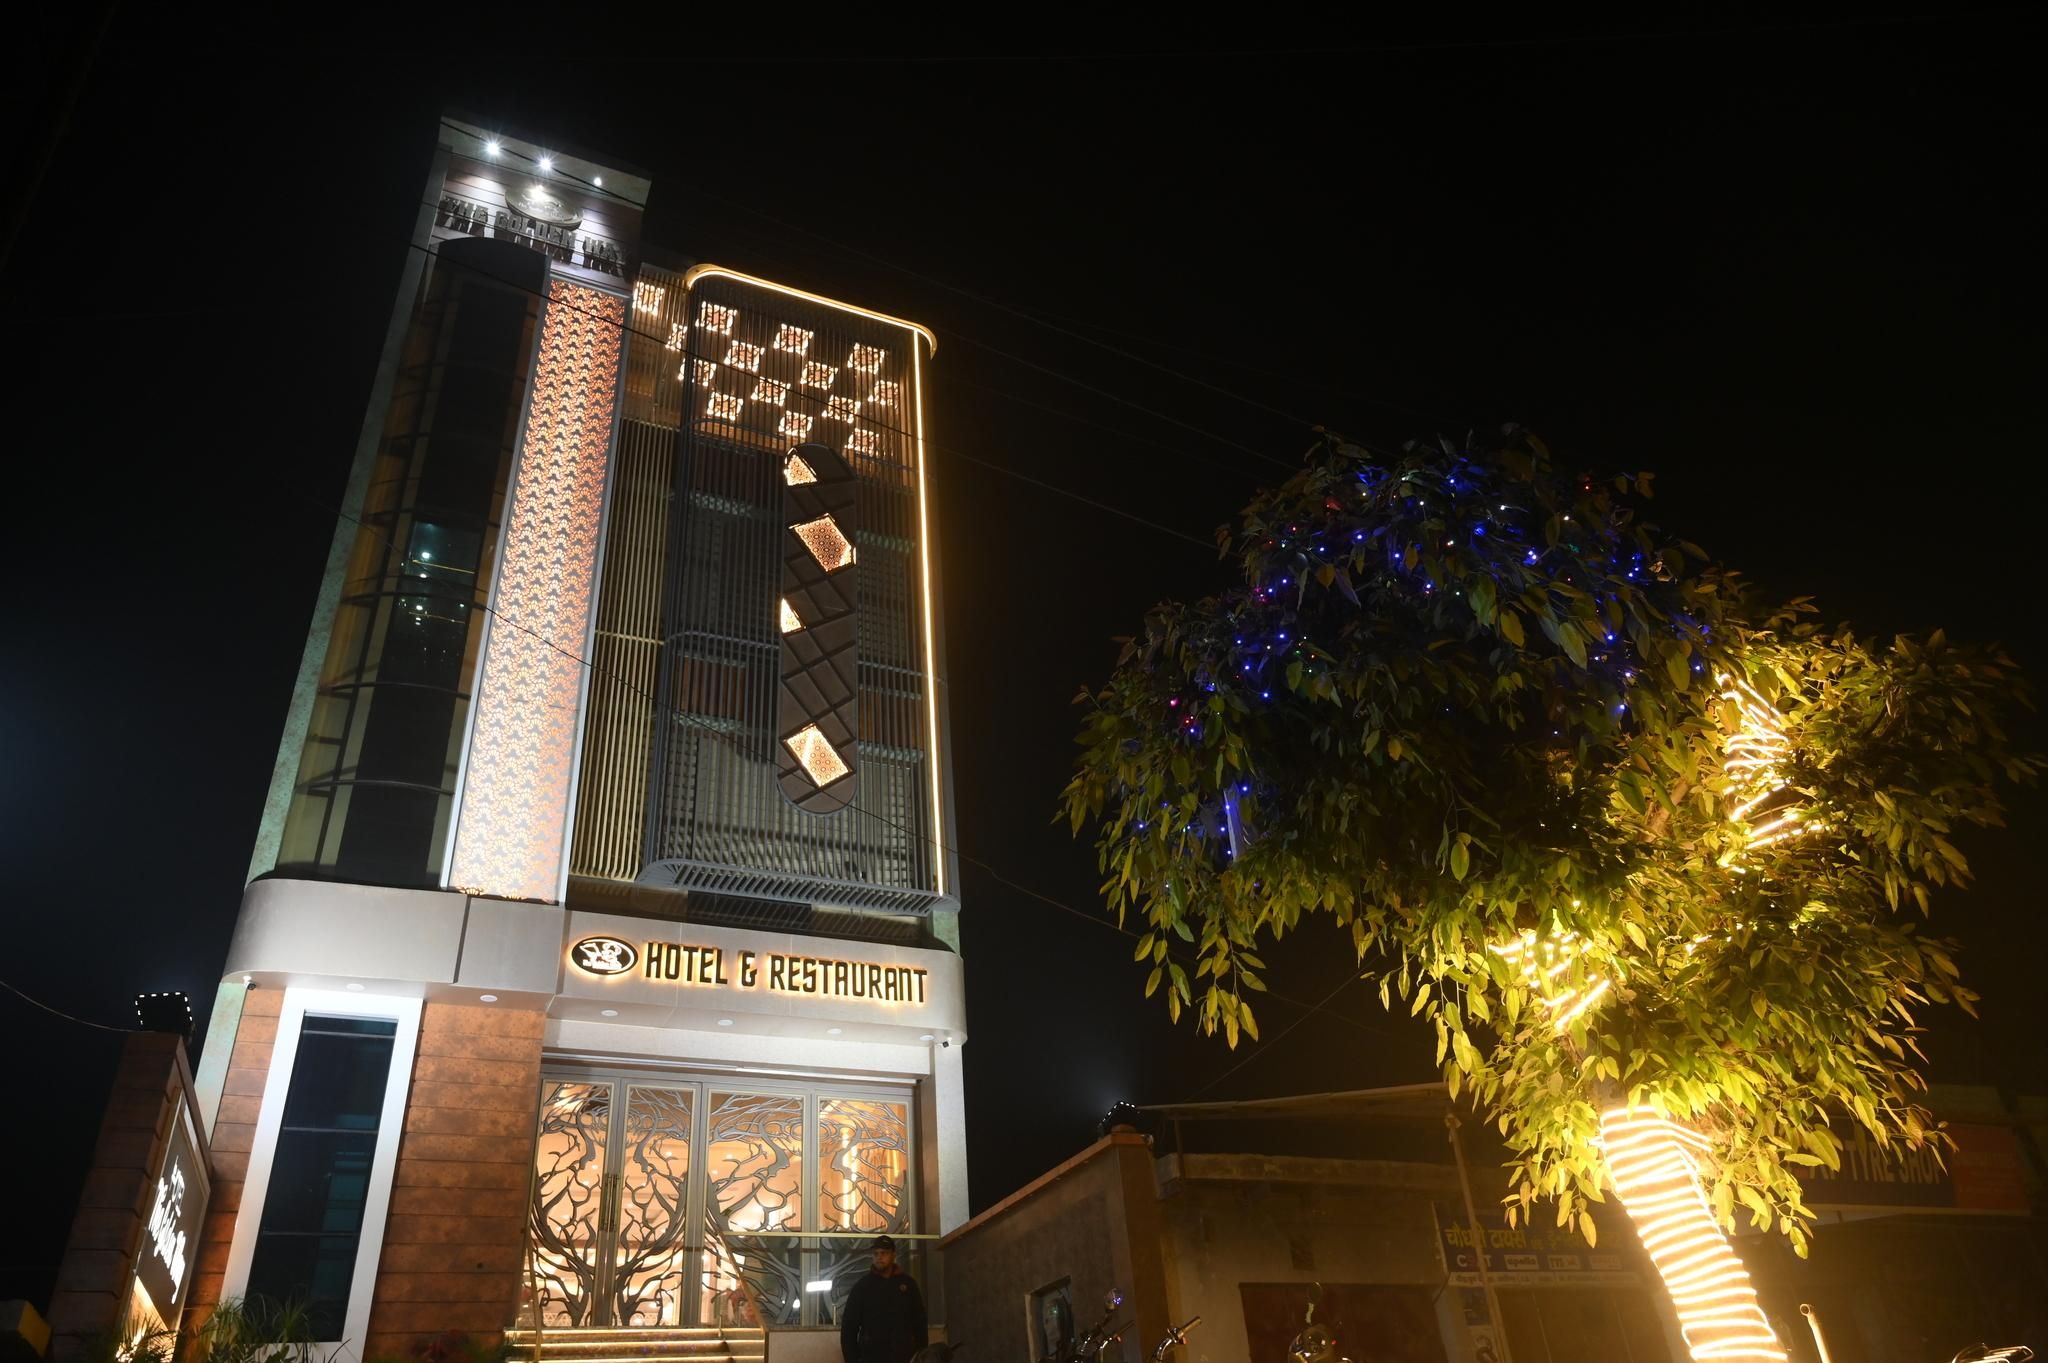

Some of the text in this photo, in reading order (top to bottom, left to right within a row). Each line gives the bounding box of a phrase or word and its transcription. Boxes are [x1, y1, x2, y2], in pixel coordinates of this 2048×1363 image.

[444, 196, 489, 222] THE
[494, 211, 577, 250] GOLDEN
[582, 236, 625, 264] WAY
[645, 942, 928, 1003] HOTEL & RESTAURANT
[1456, 1254, 1492, 1268] CT
